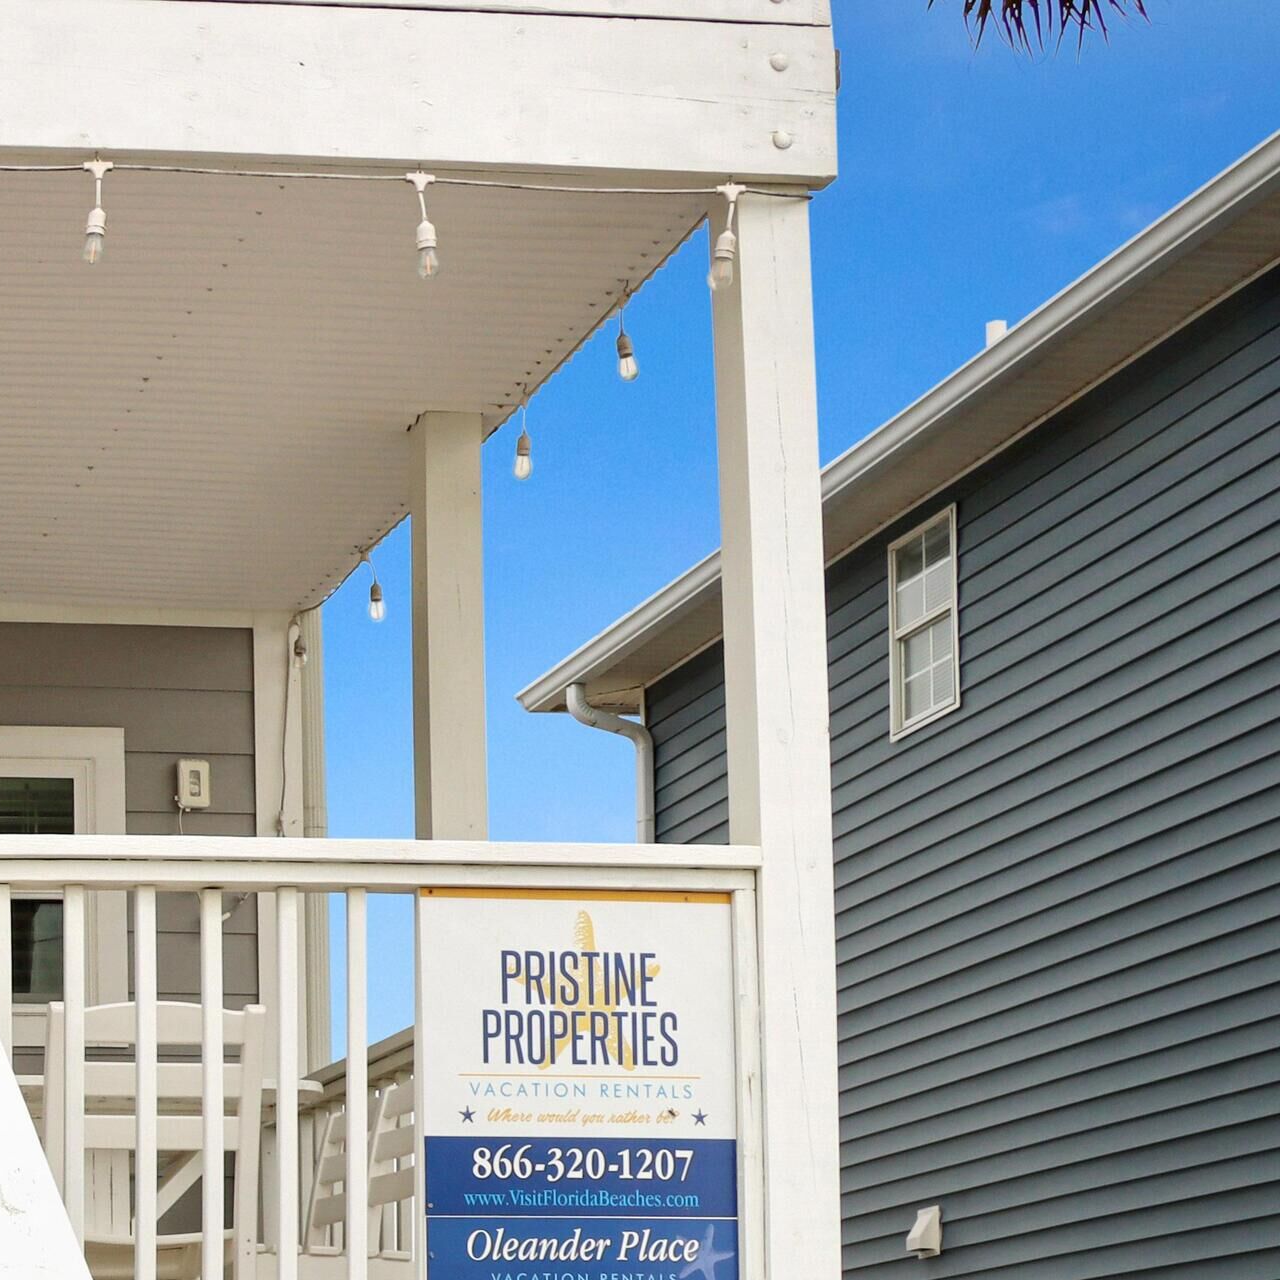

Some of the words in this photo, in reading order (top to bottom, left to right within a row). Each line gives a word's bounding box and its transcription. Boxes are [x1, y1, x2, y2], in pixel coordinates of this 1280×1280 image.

[500, 950, 658, 1007] PRISTINE
[482, 1009, 679, 1067] PROPERTIES
[469, 1081, 587, 1098] VACATION
[600, 1083, 694, 1100] RENTALS
[487, 1106, 533, 1123] Where
[537, 1107, 578, 1124] would
[582, 1112, 605, 1127] you
[608, 1108, 652, 1125] rather
[472, 1143, 694, 1183] 866-320-1207
[463, 1189, 699, 1209] www.VisitFloridaBeaches.com
[466, 1227, 612, 1262] Oleander
[616, 1228, 700, 1263] Place
